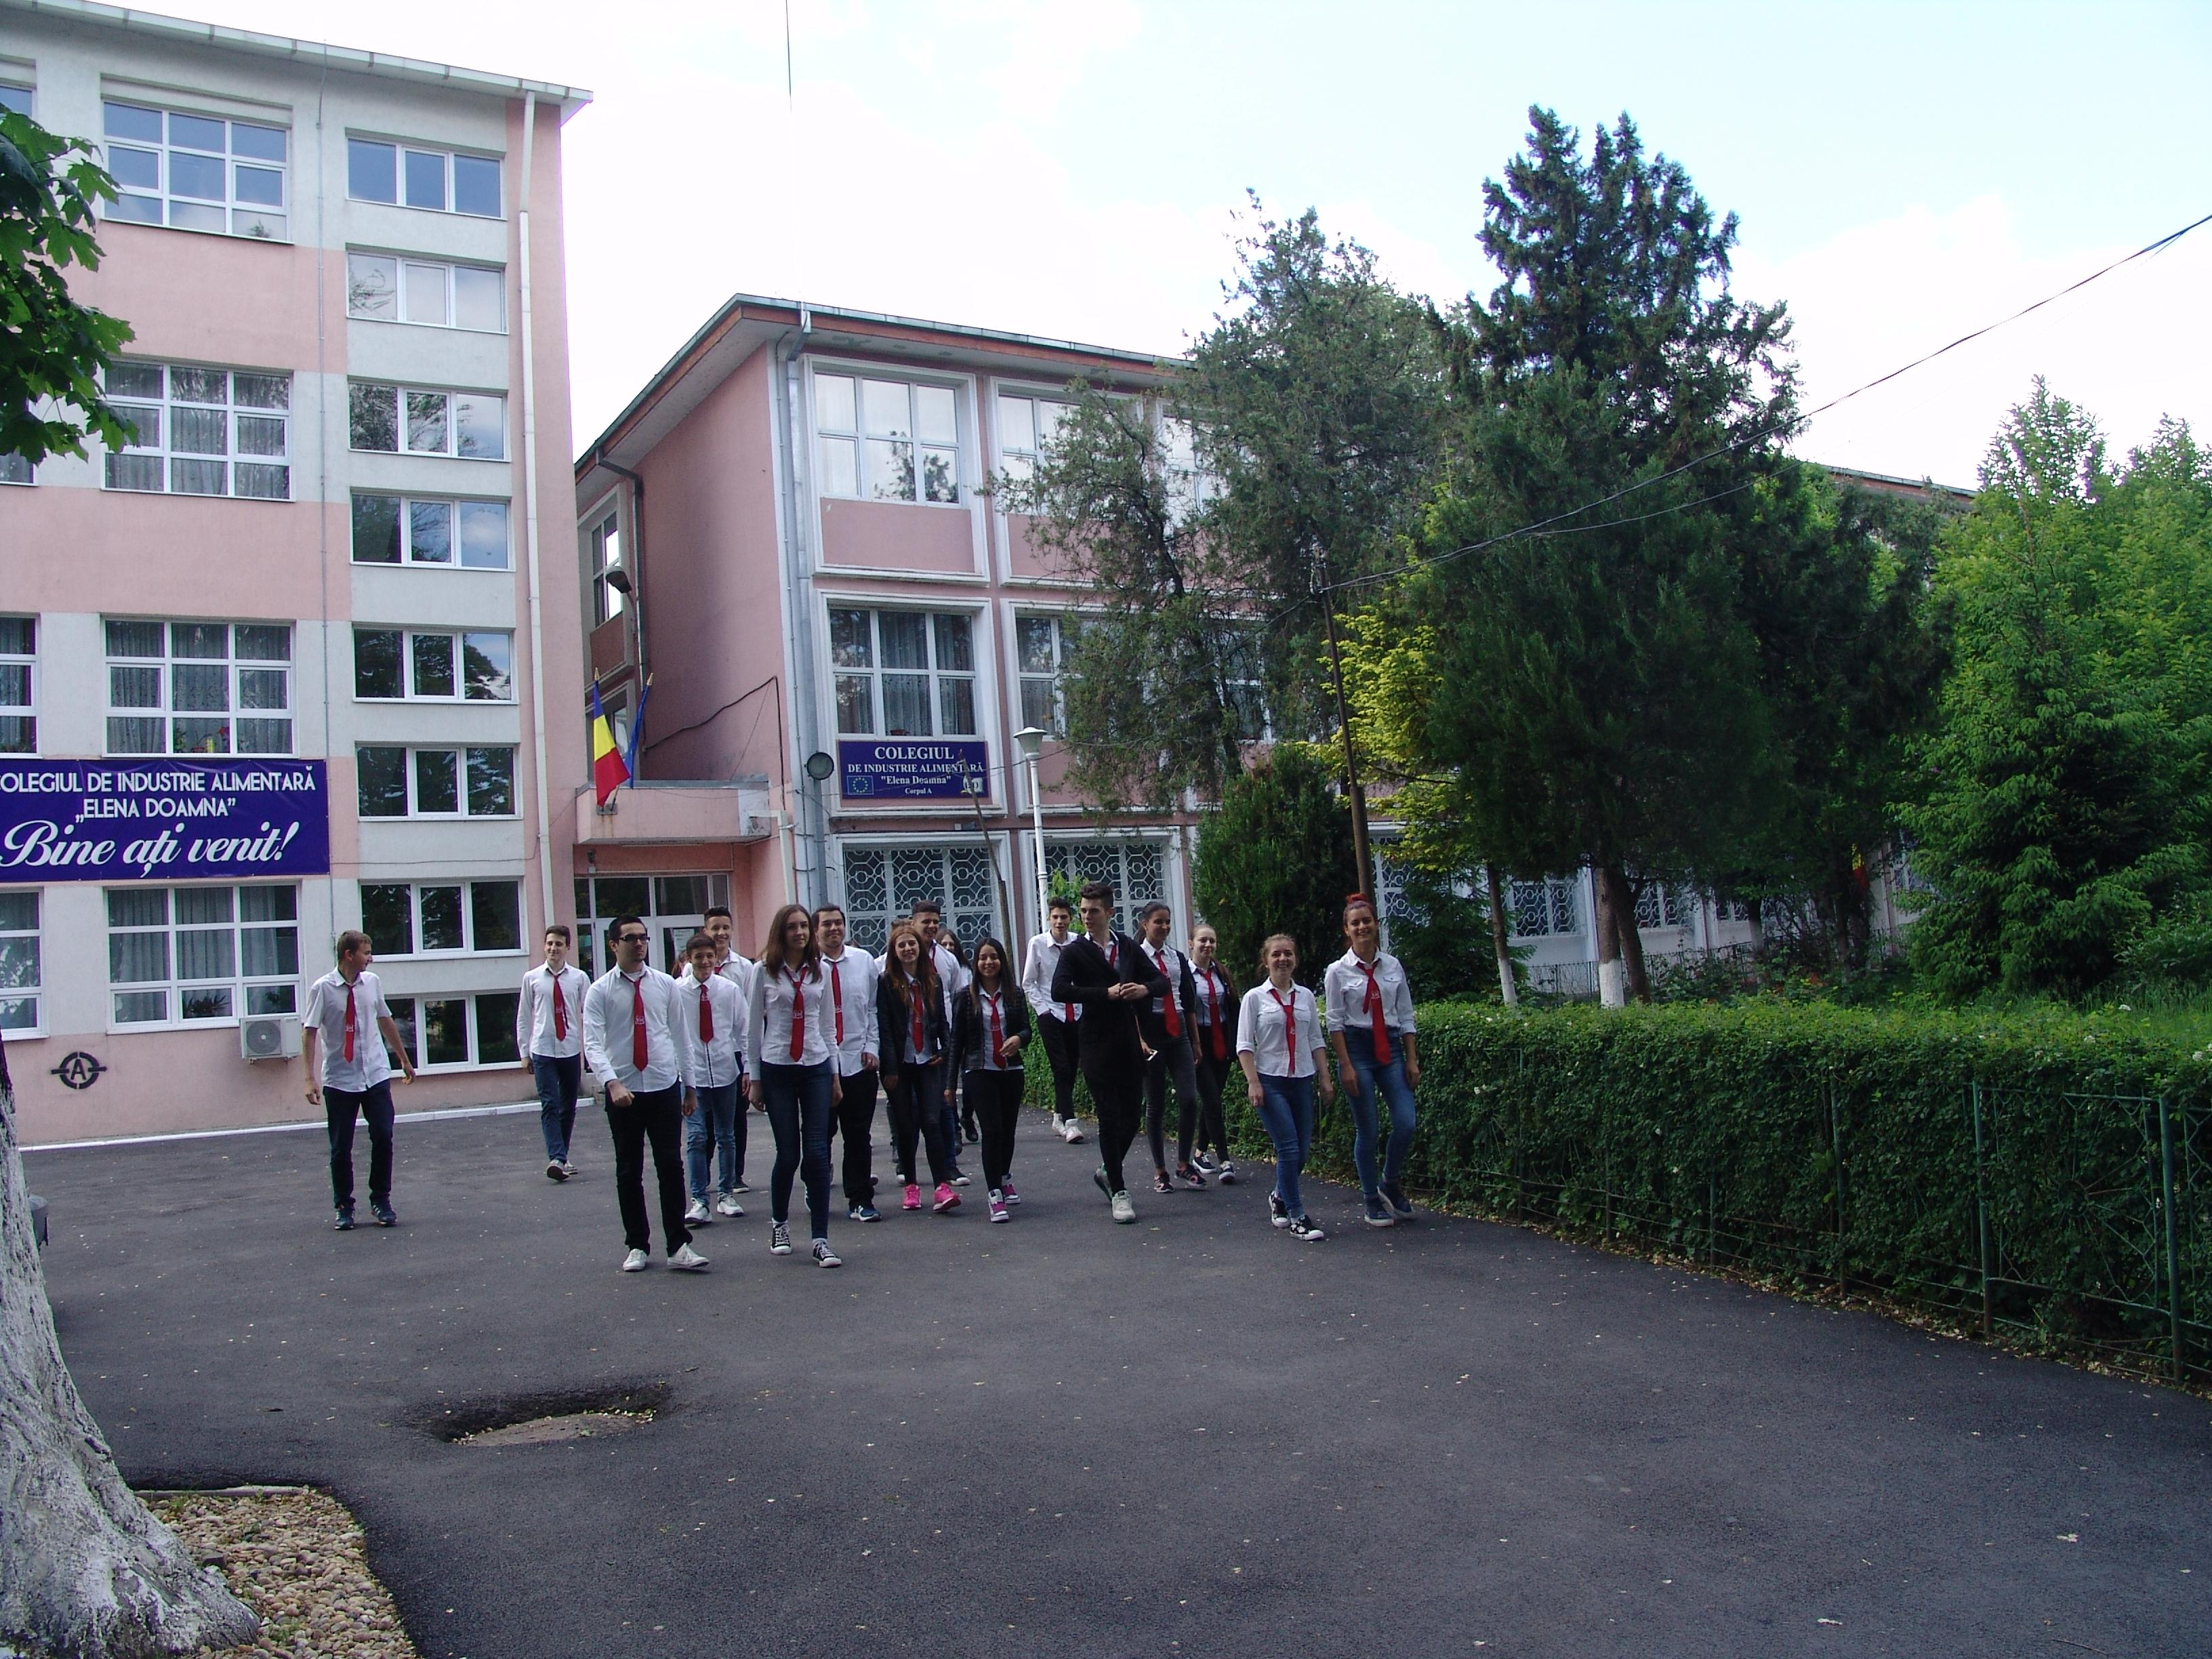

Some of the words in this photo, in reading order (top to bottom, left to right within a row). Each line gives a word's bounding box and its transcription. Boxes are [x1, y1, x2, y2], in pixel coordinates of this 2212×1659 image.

[874, 747, 954, 760] COLEGIUL
[848, 764, 861, 773] DE
[864, 764, 918, 773] INDUSTRIE
[0, 772, 83, 793] OLEGIUL
[87, 772, 112, 792] DE
[118, 771, 205, 792] INDUSTRIE
[211, 766, 316, 792] ALIMENTARĂ
[881, 775, 909, 784] "Elena
[912, 775, 951, 785] Doamna"
[75, 798, 140, 823] „ELENA
[146, 798, 236, 818] DOAMNA”
[0, 819, 117, 866] Bine
[123, 822, 184, 878] ați
[187, 821, 300, 863] venit!
[70, 1059, 87, 1080] A
